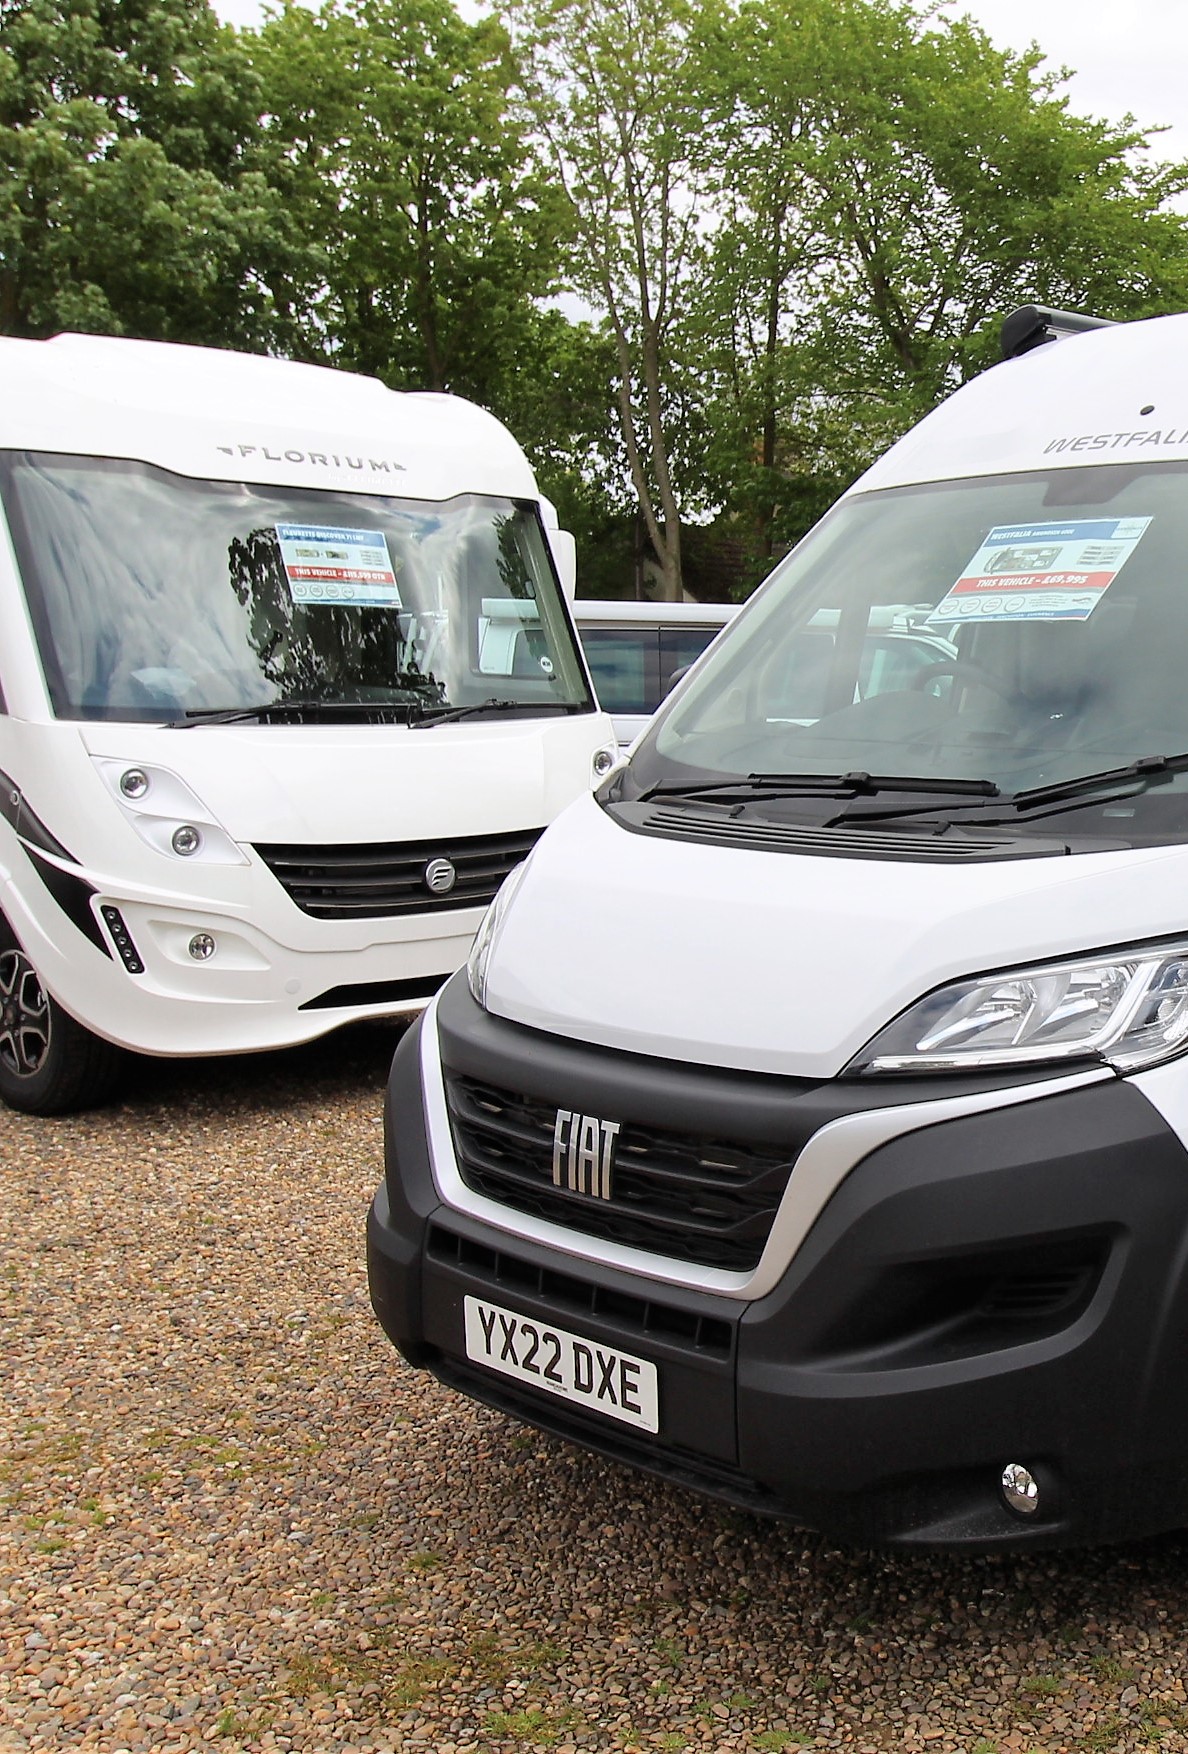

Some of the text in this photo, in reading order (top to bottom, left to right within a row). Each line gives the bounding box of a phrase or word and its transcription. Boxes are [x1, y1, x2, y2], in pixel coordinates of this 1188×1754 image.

[238, 444, 391, 473] FLORIUM
[991, 530, 1031, 540] WESTFALIA
[976, 579, 997, 587] THIS
[999, 577, 1034, 587] VEHICLE
[1041, 575, 1088, 585] £69,995
[552, 1109, 620, 1200] FIAT
[478, 1306, 642, 1415] YX22 DXE
